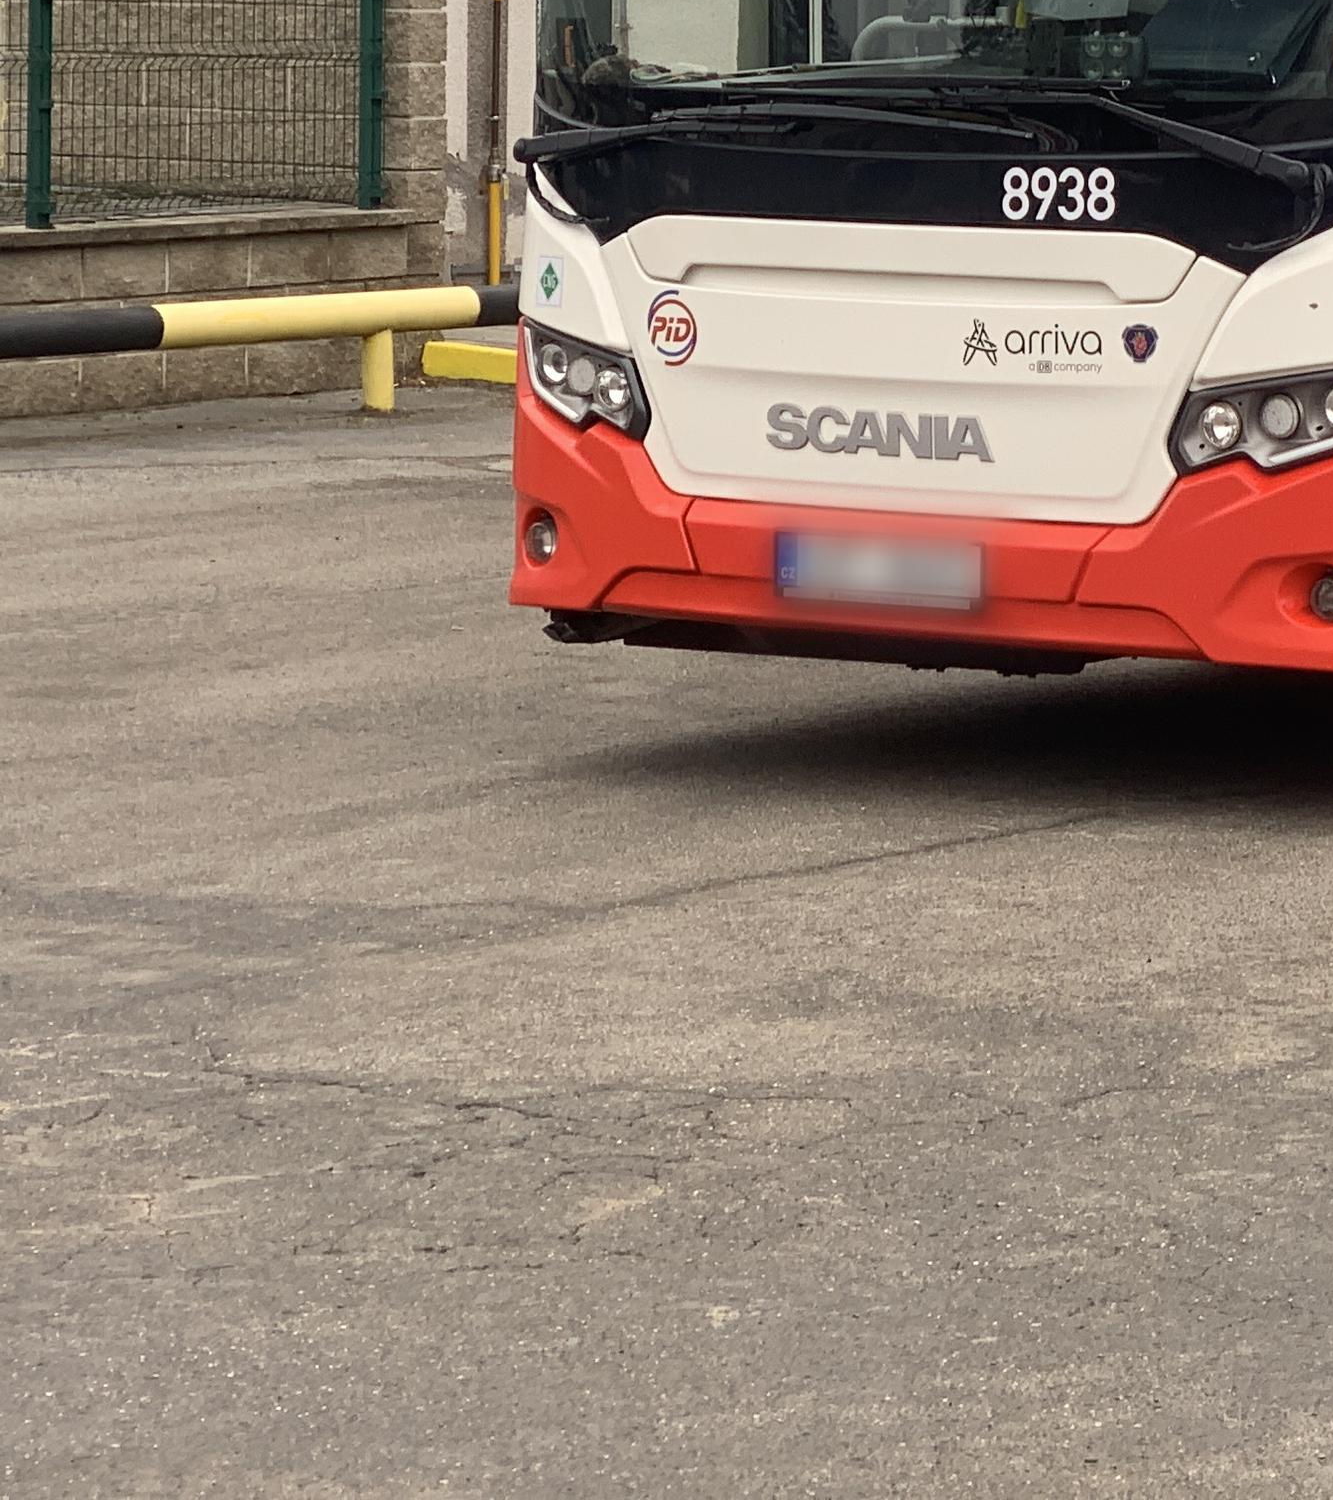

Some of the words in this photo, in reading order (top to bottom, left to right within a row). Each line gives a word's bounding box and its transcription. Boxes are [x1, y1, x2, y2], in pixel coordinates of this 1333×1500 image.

[1002, 166, 1116, 221] 8938
[1004, 323, 1102, 356] arriva
[1028, 362, 1036, 372] a
[1037, 361, 1052, 373] DB
[1053, 362, 1102, 373] company
[766, 402, 995, 464] SCANIA
[780, 565, 796, 580] CZ
